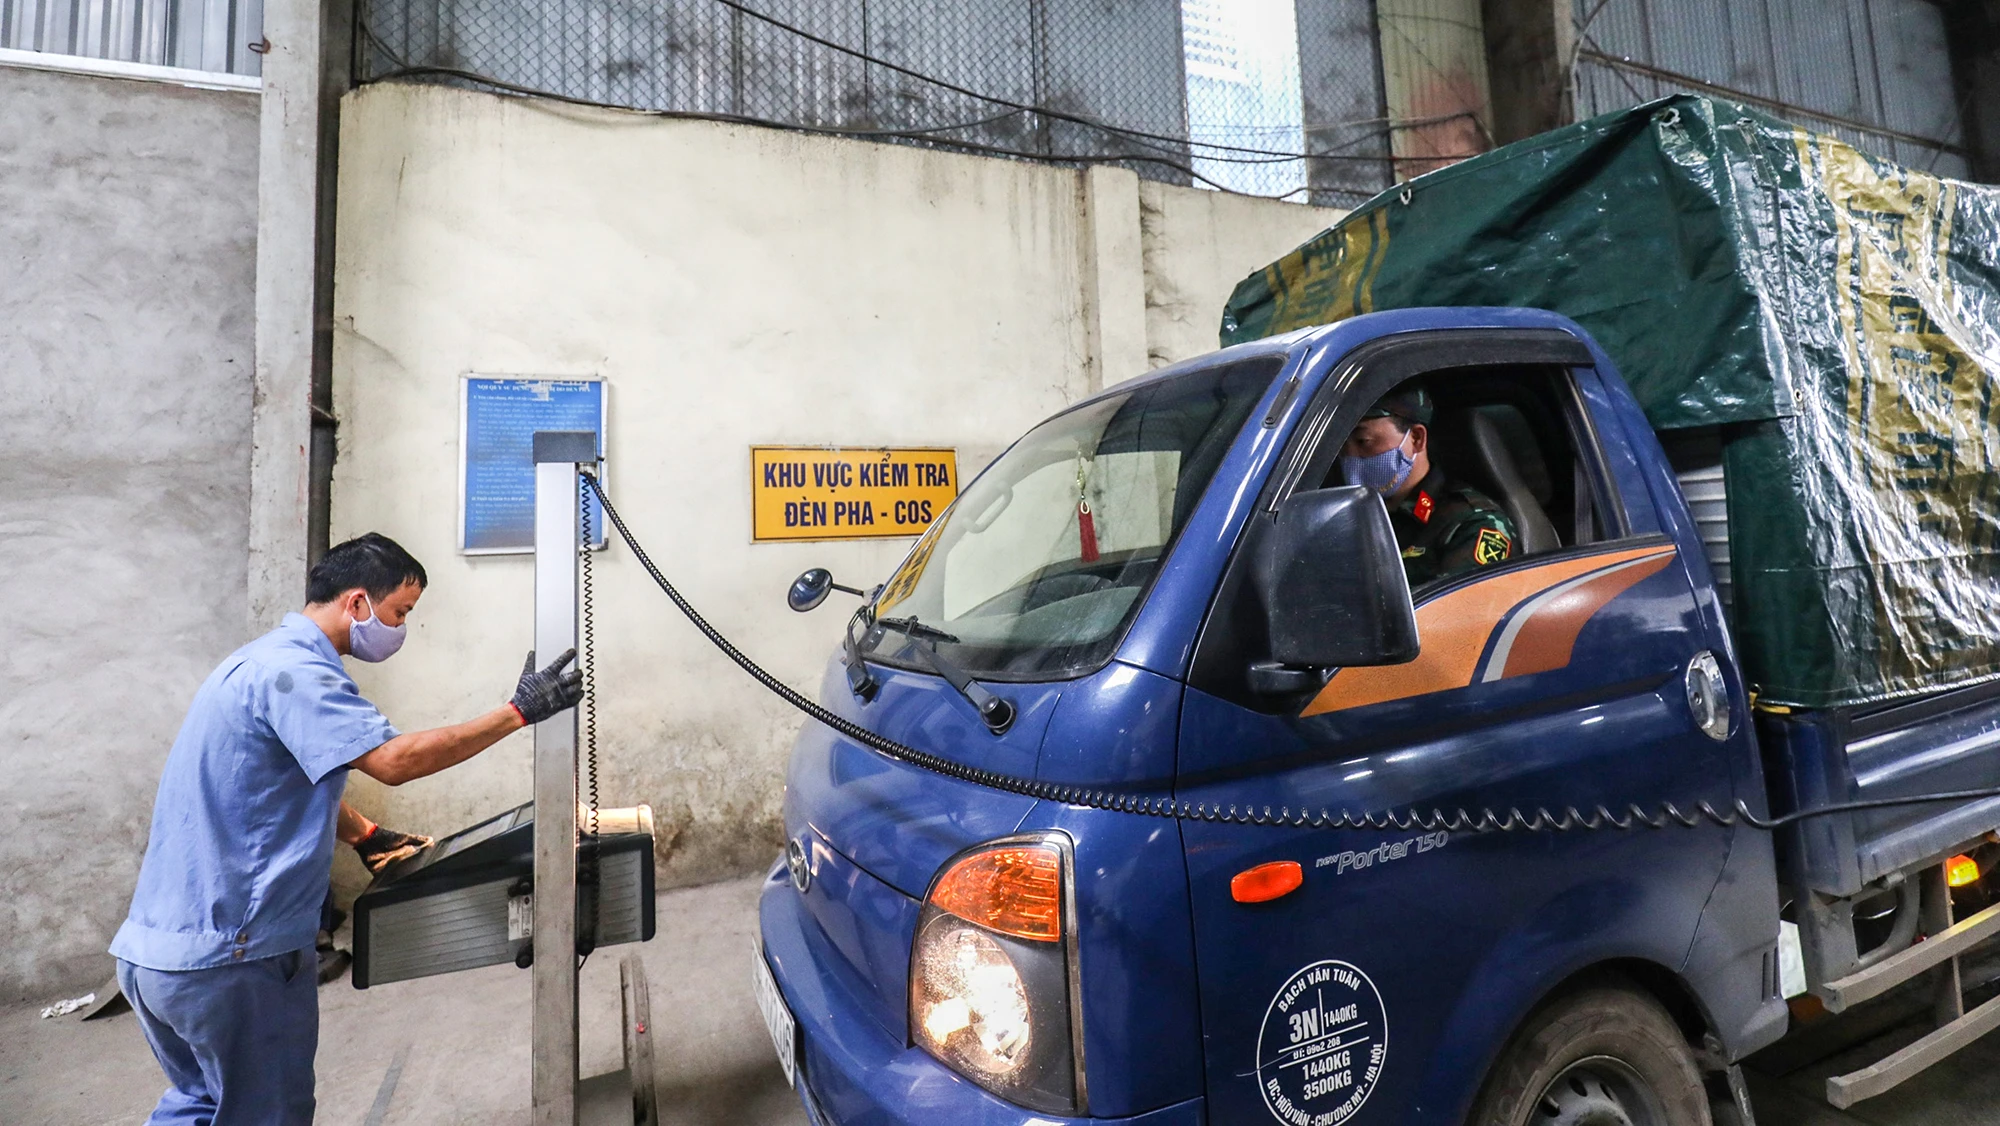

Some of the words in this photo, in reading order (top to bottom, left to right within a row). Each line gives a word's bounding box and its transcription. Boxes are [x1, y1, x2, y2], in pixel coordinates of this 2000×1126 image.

[764, 463, 806, 488] KHU
[813, 460, 853, 493] VỰC
[860, 453, 909, 488] KIỂM
[915, 463, 949, 487] TRA
[784, 496, 826, 527] ĐÈN
[834, 501, 874, 526] PHA
[894, 500, 932, 525] COS
[1316, 854, 1339, 868] new
[1337, 838, 1414, 875] Porter
[1416, 830, 1449, 853] 150
[1278, 978, 1307, 1012] BẠCH
[1307, 967, 1330, 985] VĂN
[1289, 1007, 1318, 1043] 3N
[1324, 1003, 1357, 1027] 1440KG
[1266, 1078, 1281, 1101] ĐC:
[1370, 1043, 1384, 1065] NỘI
[1302, 1050, 1351, 1080] 1440KG
[1303, 1069, 1352, 1100] 3500KG
